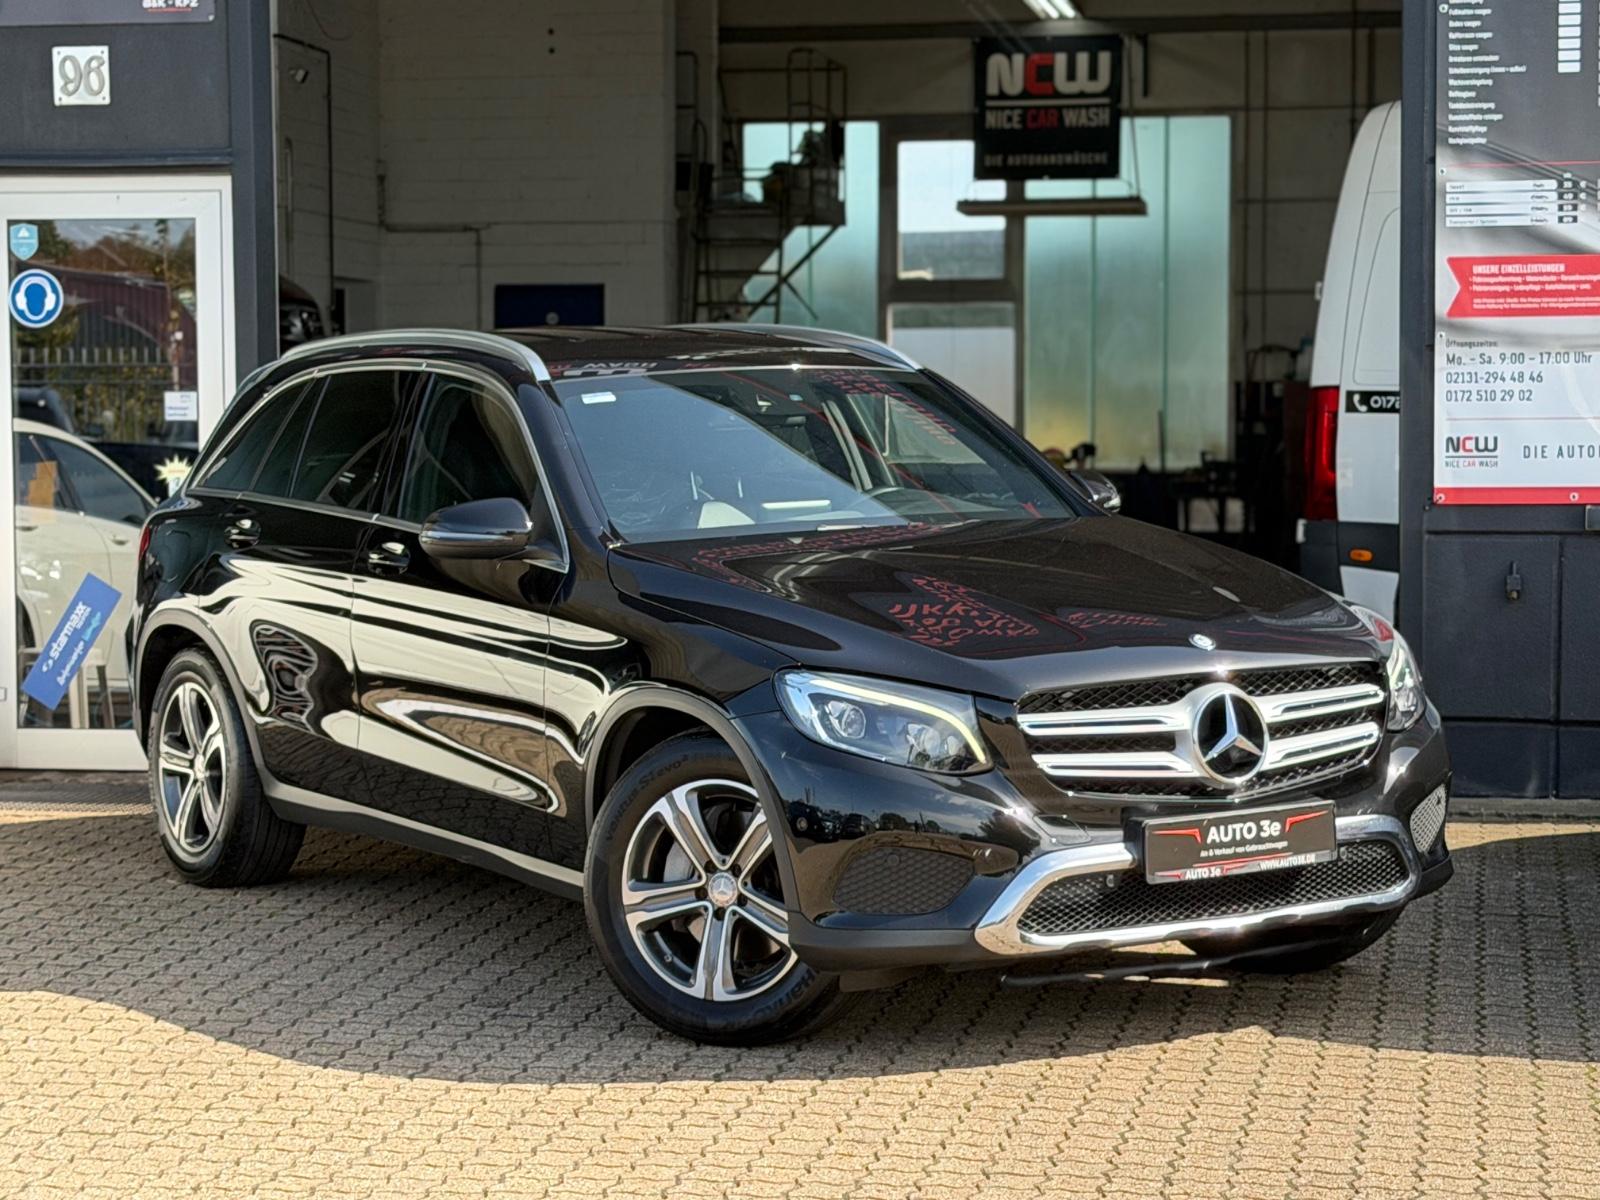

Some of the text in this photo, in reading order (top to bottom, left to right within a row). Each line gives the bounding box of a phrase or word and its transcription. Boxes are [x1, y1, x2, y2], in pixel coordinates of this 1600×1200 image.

[58, 54, 106, 97] 96
[986, 50, 1112, 97] NCW
[985, 107, 1111, 129] NICE CAR WASH
[1446, 353, 1466, 366] Mo.
[1479, 353, 1495, 365] Sa.
[1499, 352, 1525, 365] 9:00
[1539, 351, 1570, 364] 17:00
[1573, 351, 1592, 364] Uhr
[1446, 371, 1543, 384] 02131-294 48 46
[1446, 389, 1533, 402] 0172 510 29 02
[1445, 436, 1498, 453] NCW
[1523, 444, 1600, 459] DIE AUTO
[1479, 460, 1498, 468] WASH
[1206, 819, 1281, 844] AUTO 3e
[1185, 868, 1209, 880] AUTO
